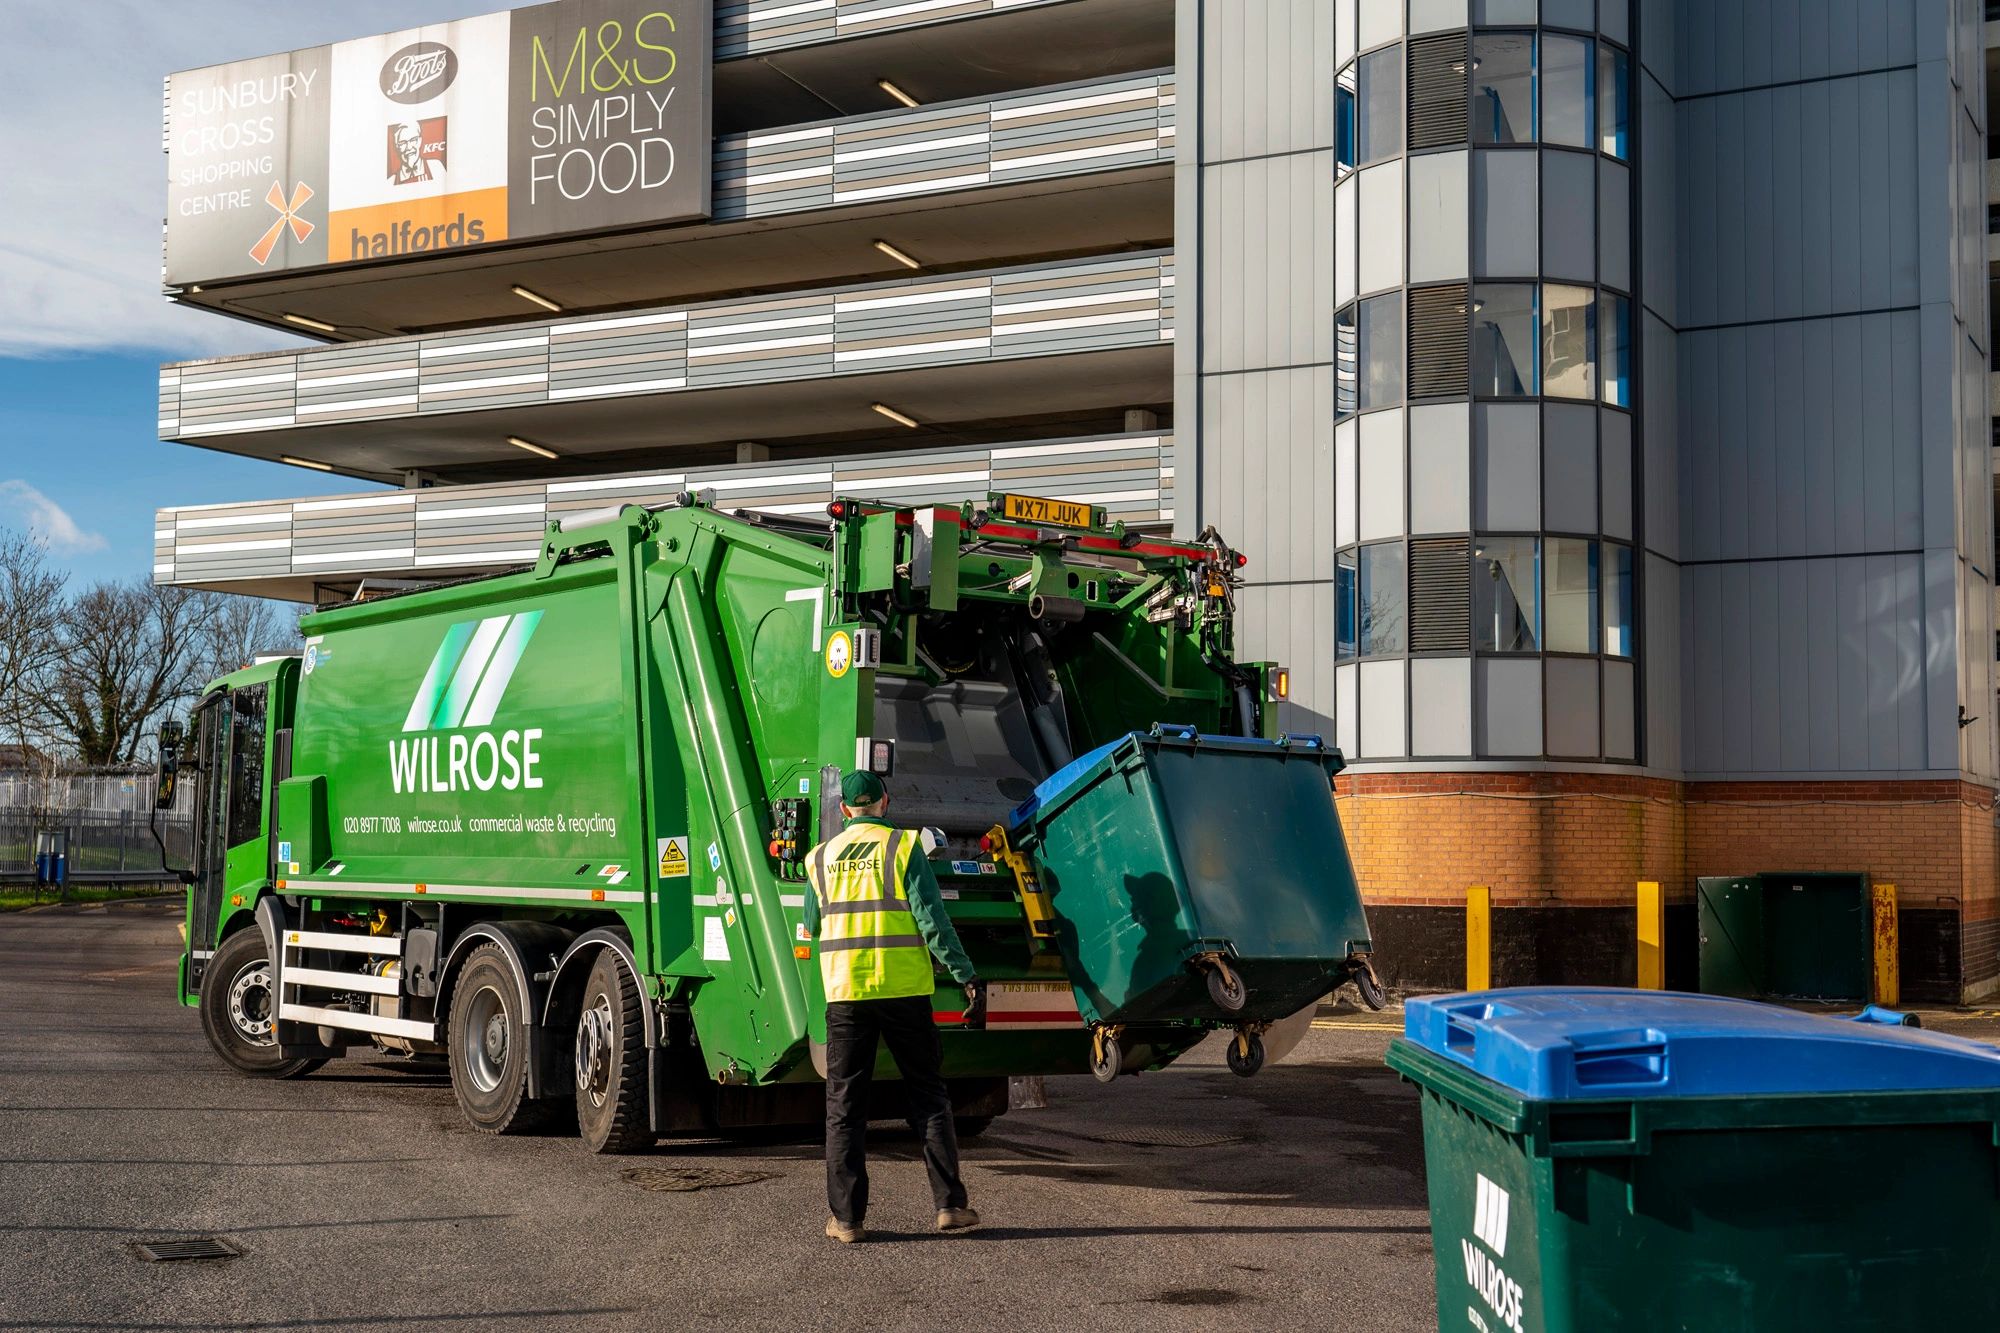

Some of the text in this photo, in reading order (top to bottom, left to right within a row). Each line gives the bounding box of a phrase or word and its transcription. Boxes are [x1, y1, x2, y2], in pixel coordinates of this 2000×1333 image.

[387, 50, 447, 95] Boots
[532, 12, 677, 103] M&S
[181, 68, 317, 117] SUNBURY
[181, 116, 274, 156] CROSS
[531, 87, 676, 149] SIMPLY
[423, 141, 446, 153] KFC
[180, 155, 273, 187] SHOPPING
[531, 137, 675, 205] FOOD
[180, 188, 253, 217] CENTRE
[351, 213, 485, 260] halfords
[1015, 498, 1081, 524] WX71 JUK
[389, 728, 544, 794] WILROSE
[344, 813, 616, 838] 020 8977 7008 wilrose.co.uk commercial waste & recycling
[827, 859, 880, 874] WILROSE
[1461, 1238, 1523, 1333] WILROSE
